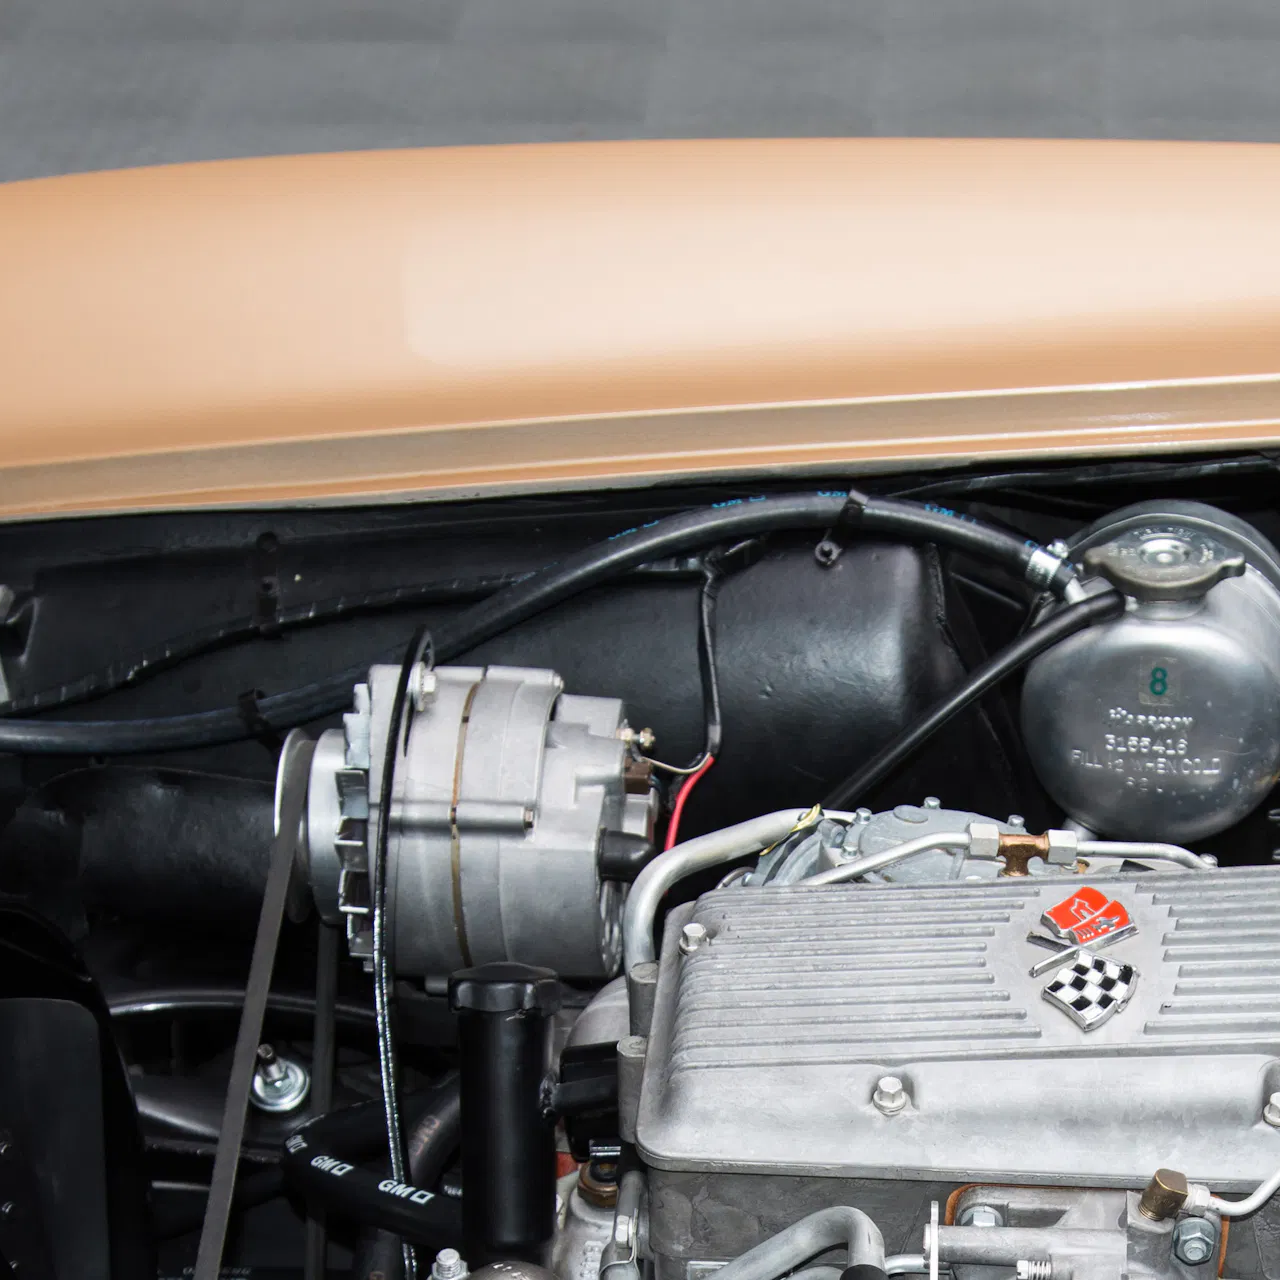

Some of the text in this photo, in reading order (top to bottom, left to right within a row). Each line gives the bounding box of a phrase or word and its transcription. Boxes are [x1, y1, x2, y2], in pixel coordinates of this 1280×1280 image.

[1149, 667, 1168, 695] 8
[310, 1155, 340, 1172] GM
[378, 1179, 411, 1198] GM
